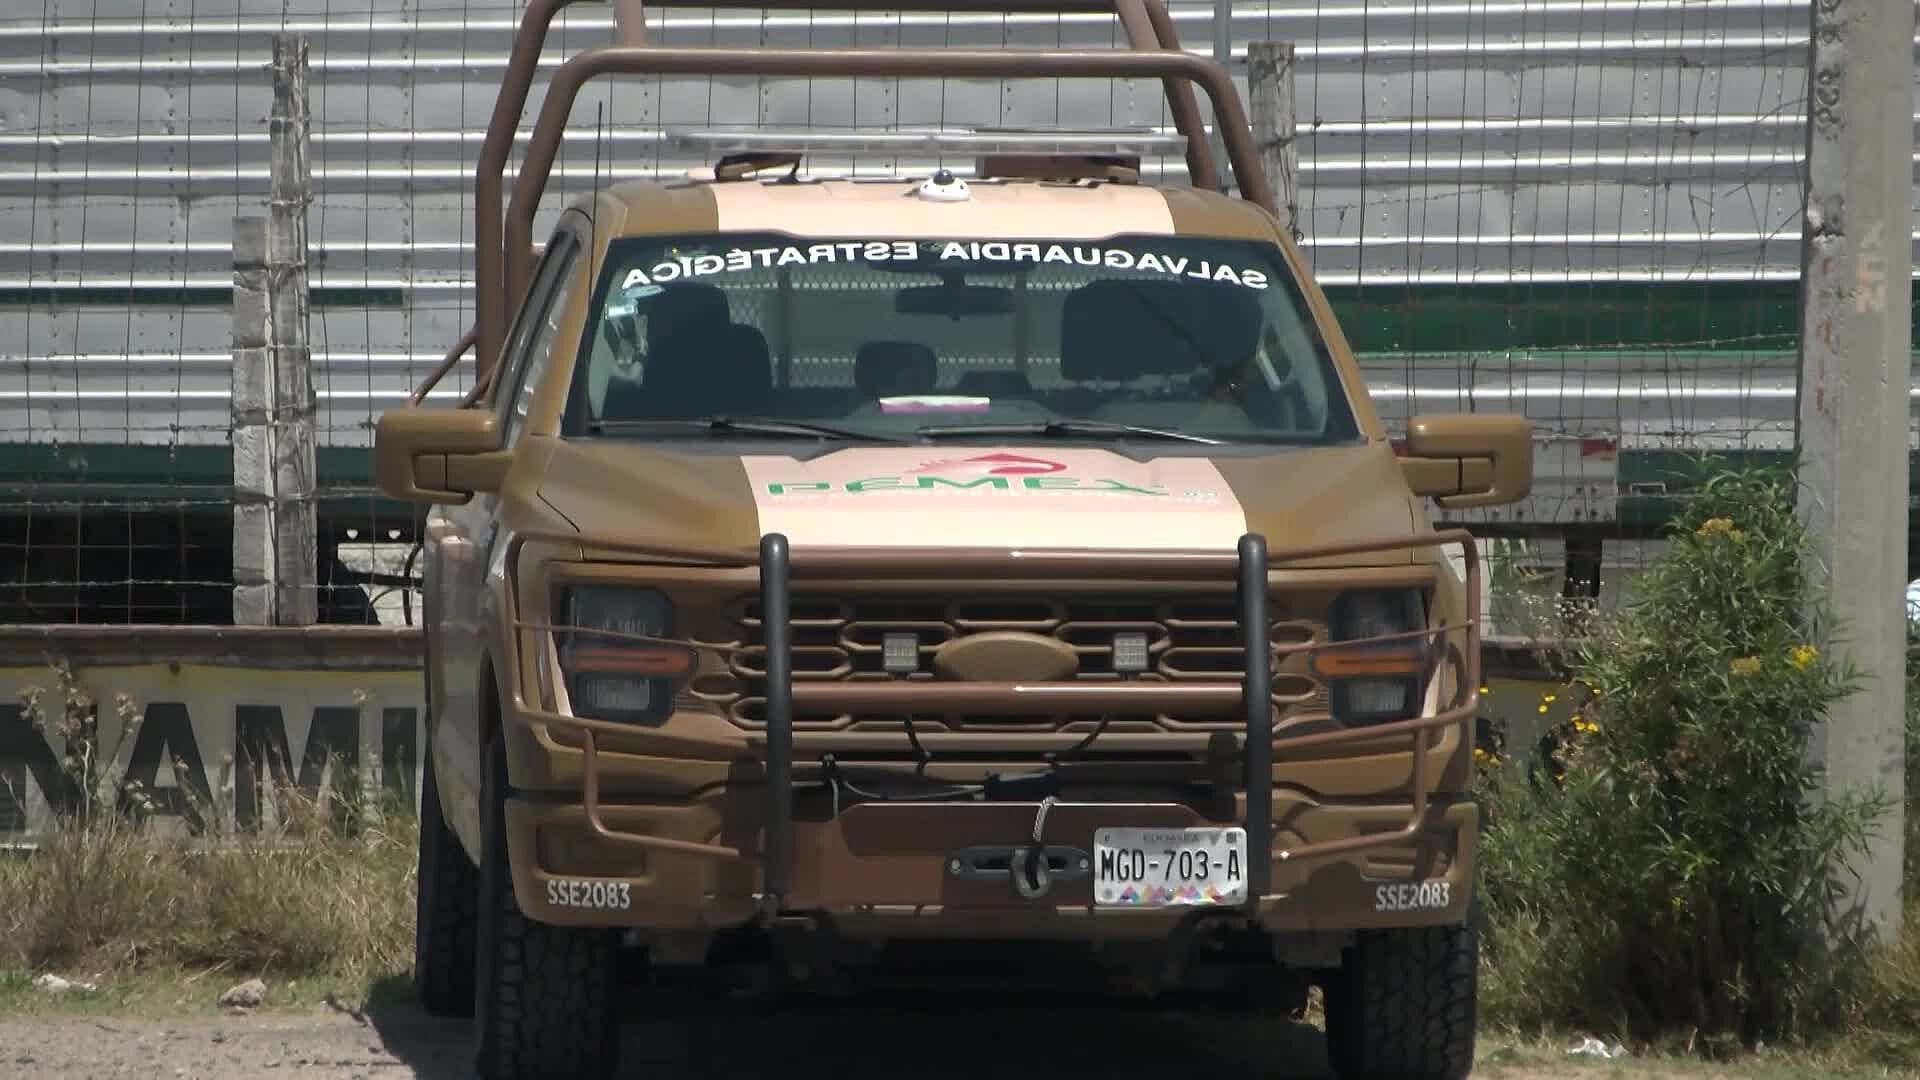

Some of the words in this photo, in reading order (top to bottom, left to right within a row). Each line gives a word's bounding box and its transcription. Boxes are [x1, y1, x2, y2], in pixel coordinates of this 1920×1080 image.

[767, 475, 1170, 496] PEMEX
[1100, 848, 1241, 882] MGD-703-A
[547, 879, 631, 909] SSE2083
[1376, 882, 1450, 912] SSE2083
